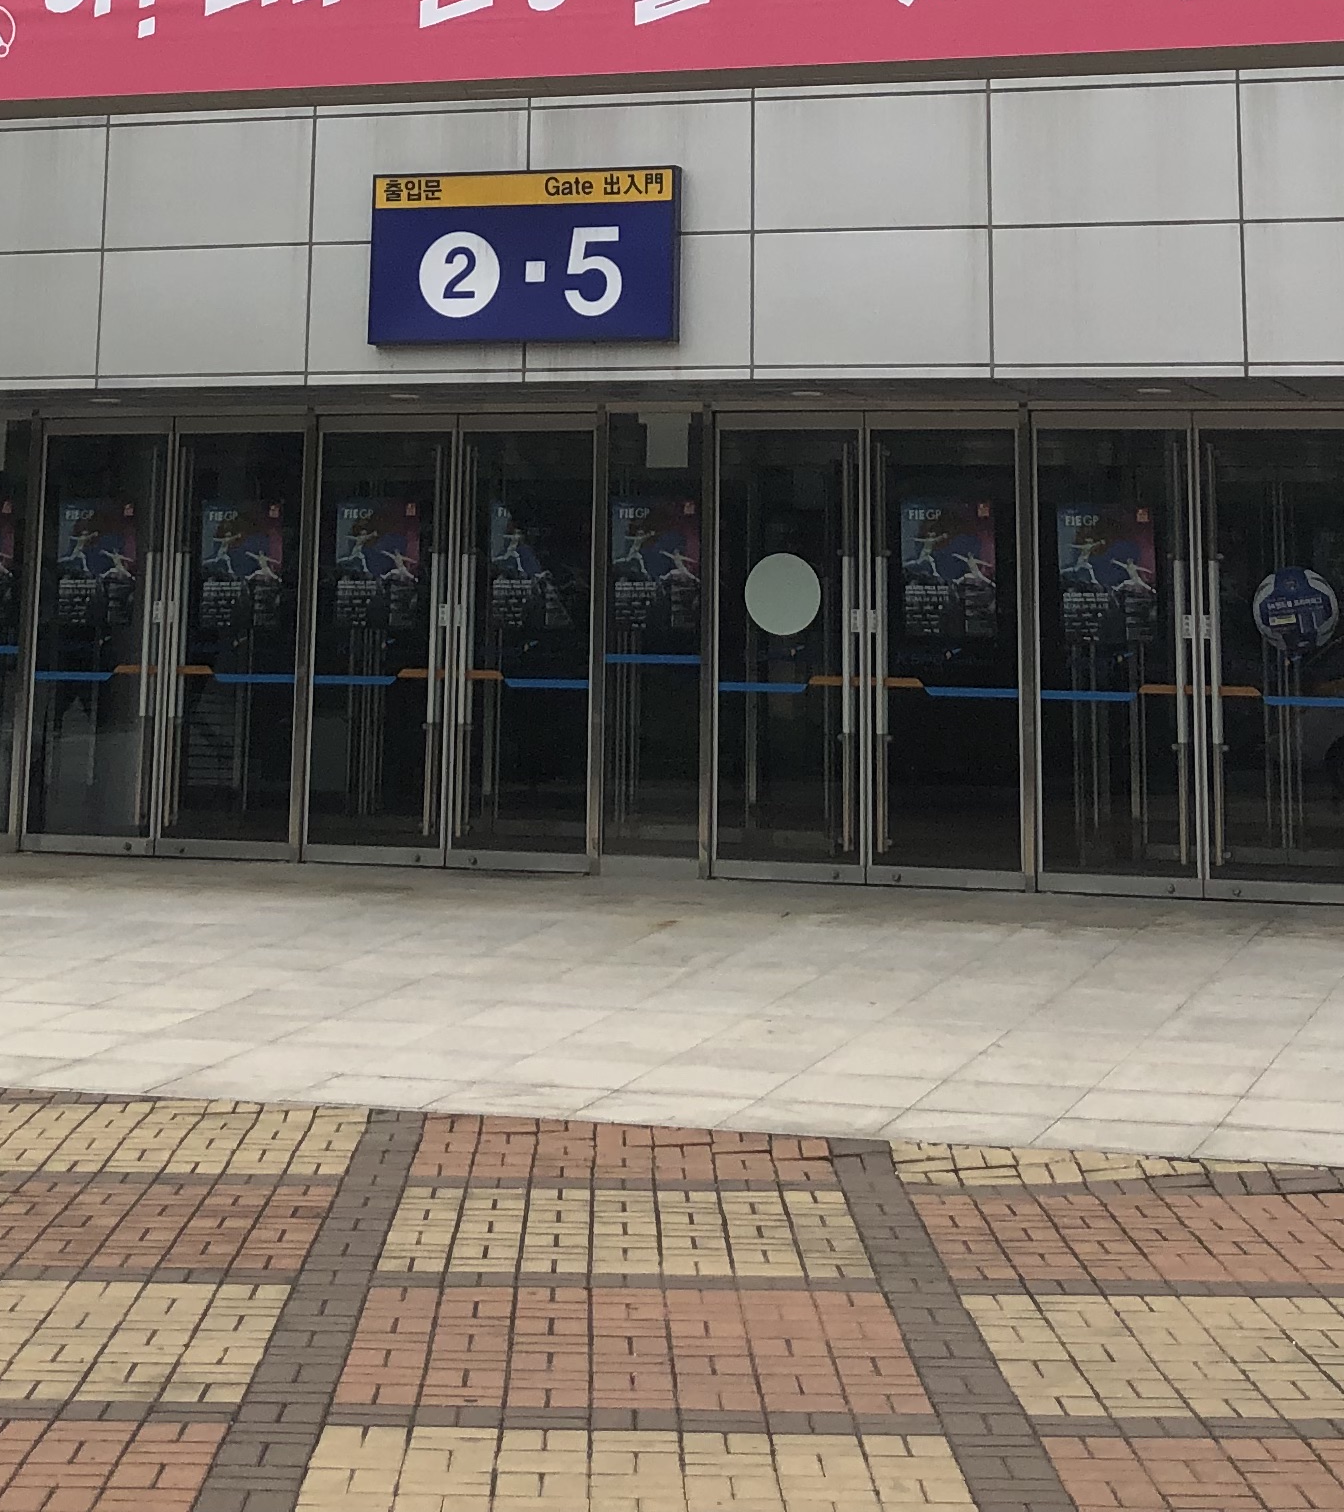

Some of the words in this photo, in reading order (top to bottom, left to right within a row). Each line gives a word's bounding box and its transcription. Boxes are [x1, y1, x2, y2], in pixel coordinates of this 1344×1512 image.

[383, 179, 443, 202] 출입문
[544, 176, 594, 197] Gate
[603, 172, 665, 196] 出入門
